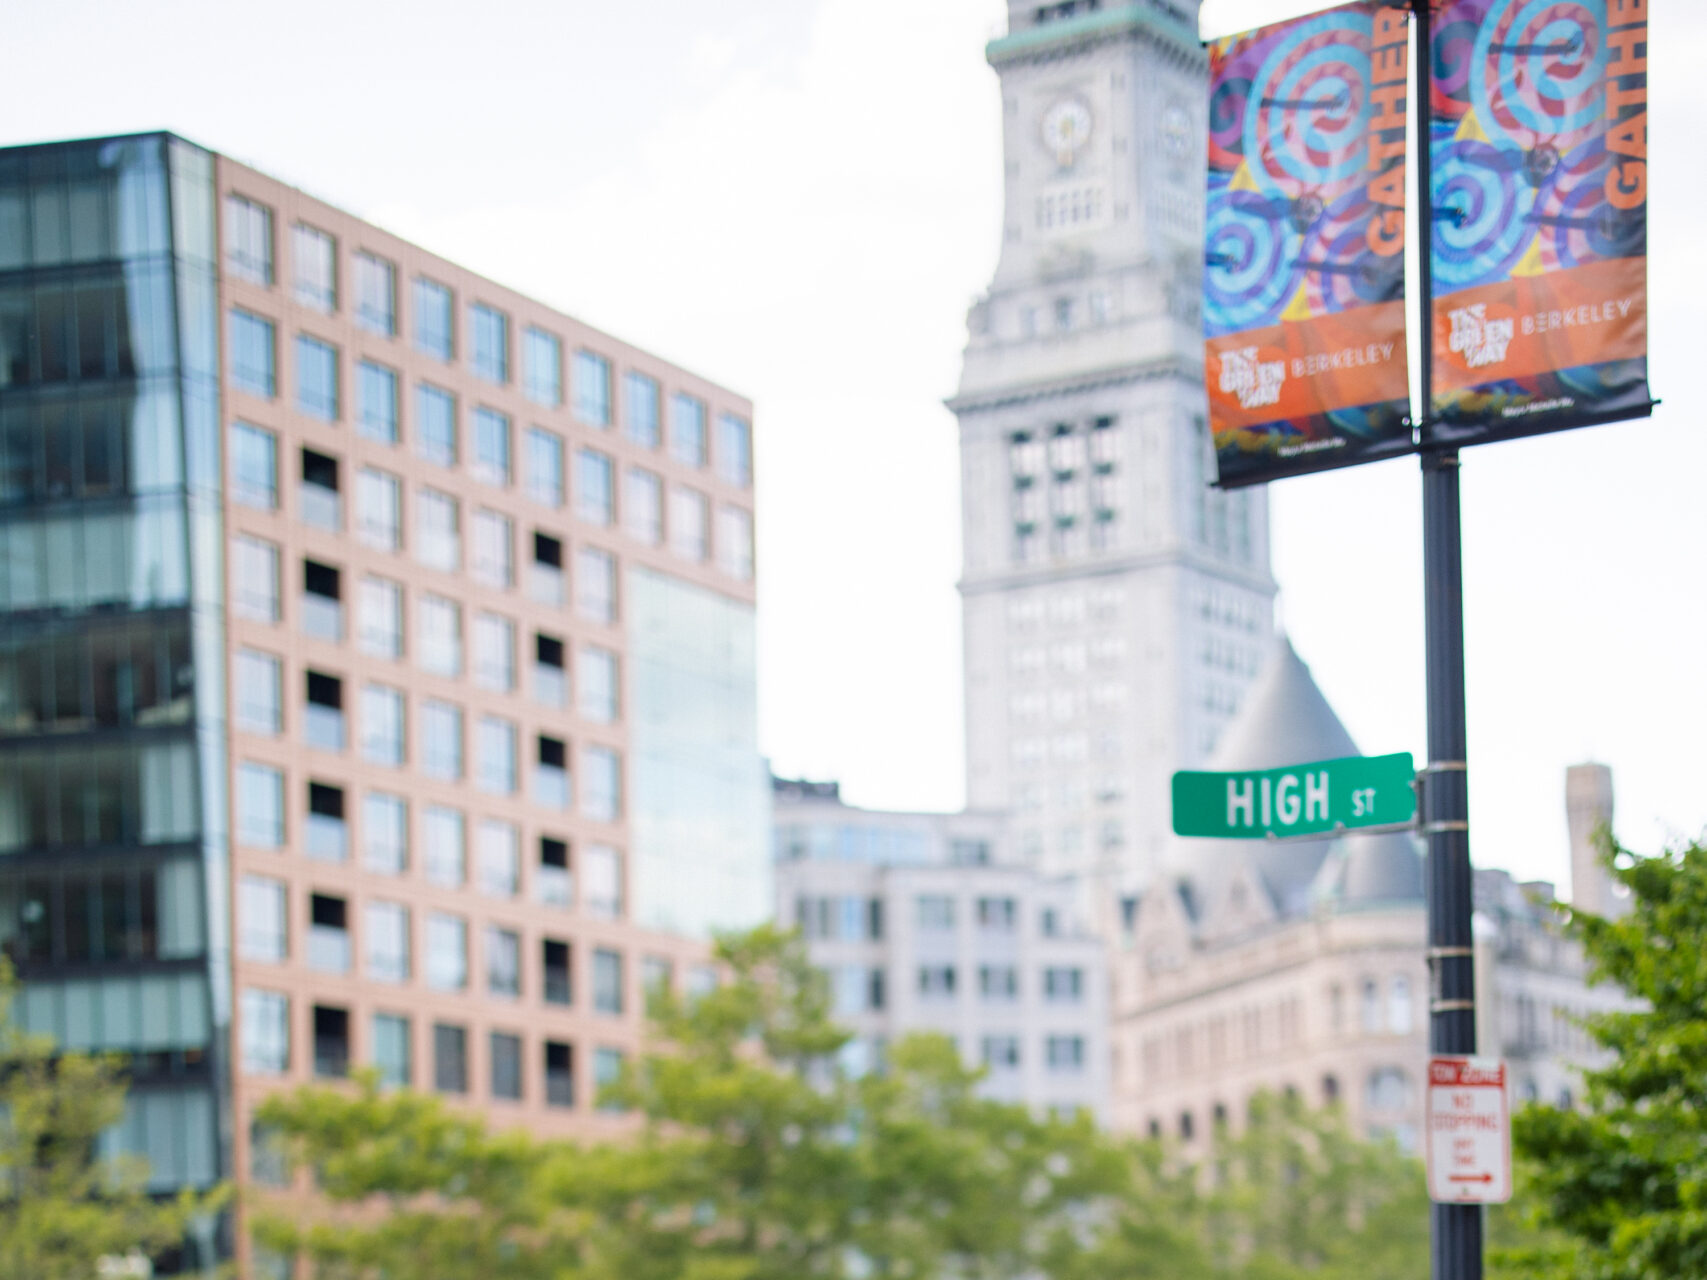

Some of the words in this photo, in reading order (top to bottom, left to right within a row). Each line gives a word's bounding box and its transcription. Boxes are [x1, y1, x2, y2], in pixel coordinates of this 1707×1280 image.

[1367, 5, 1410, 256] GATHER
[1521, 298, 1632, 336] BERKELEY
[1291, 341, 1394, 377] BERKELEY
[1226, 770, 1330, 828] HIGH
[1352, 787, 1376, 817] ST
[1452, 1093, 1473, 1108] NO
[1433, 1113, 1498, 1131] STOPPING
